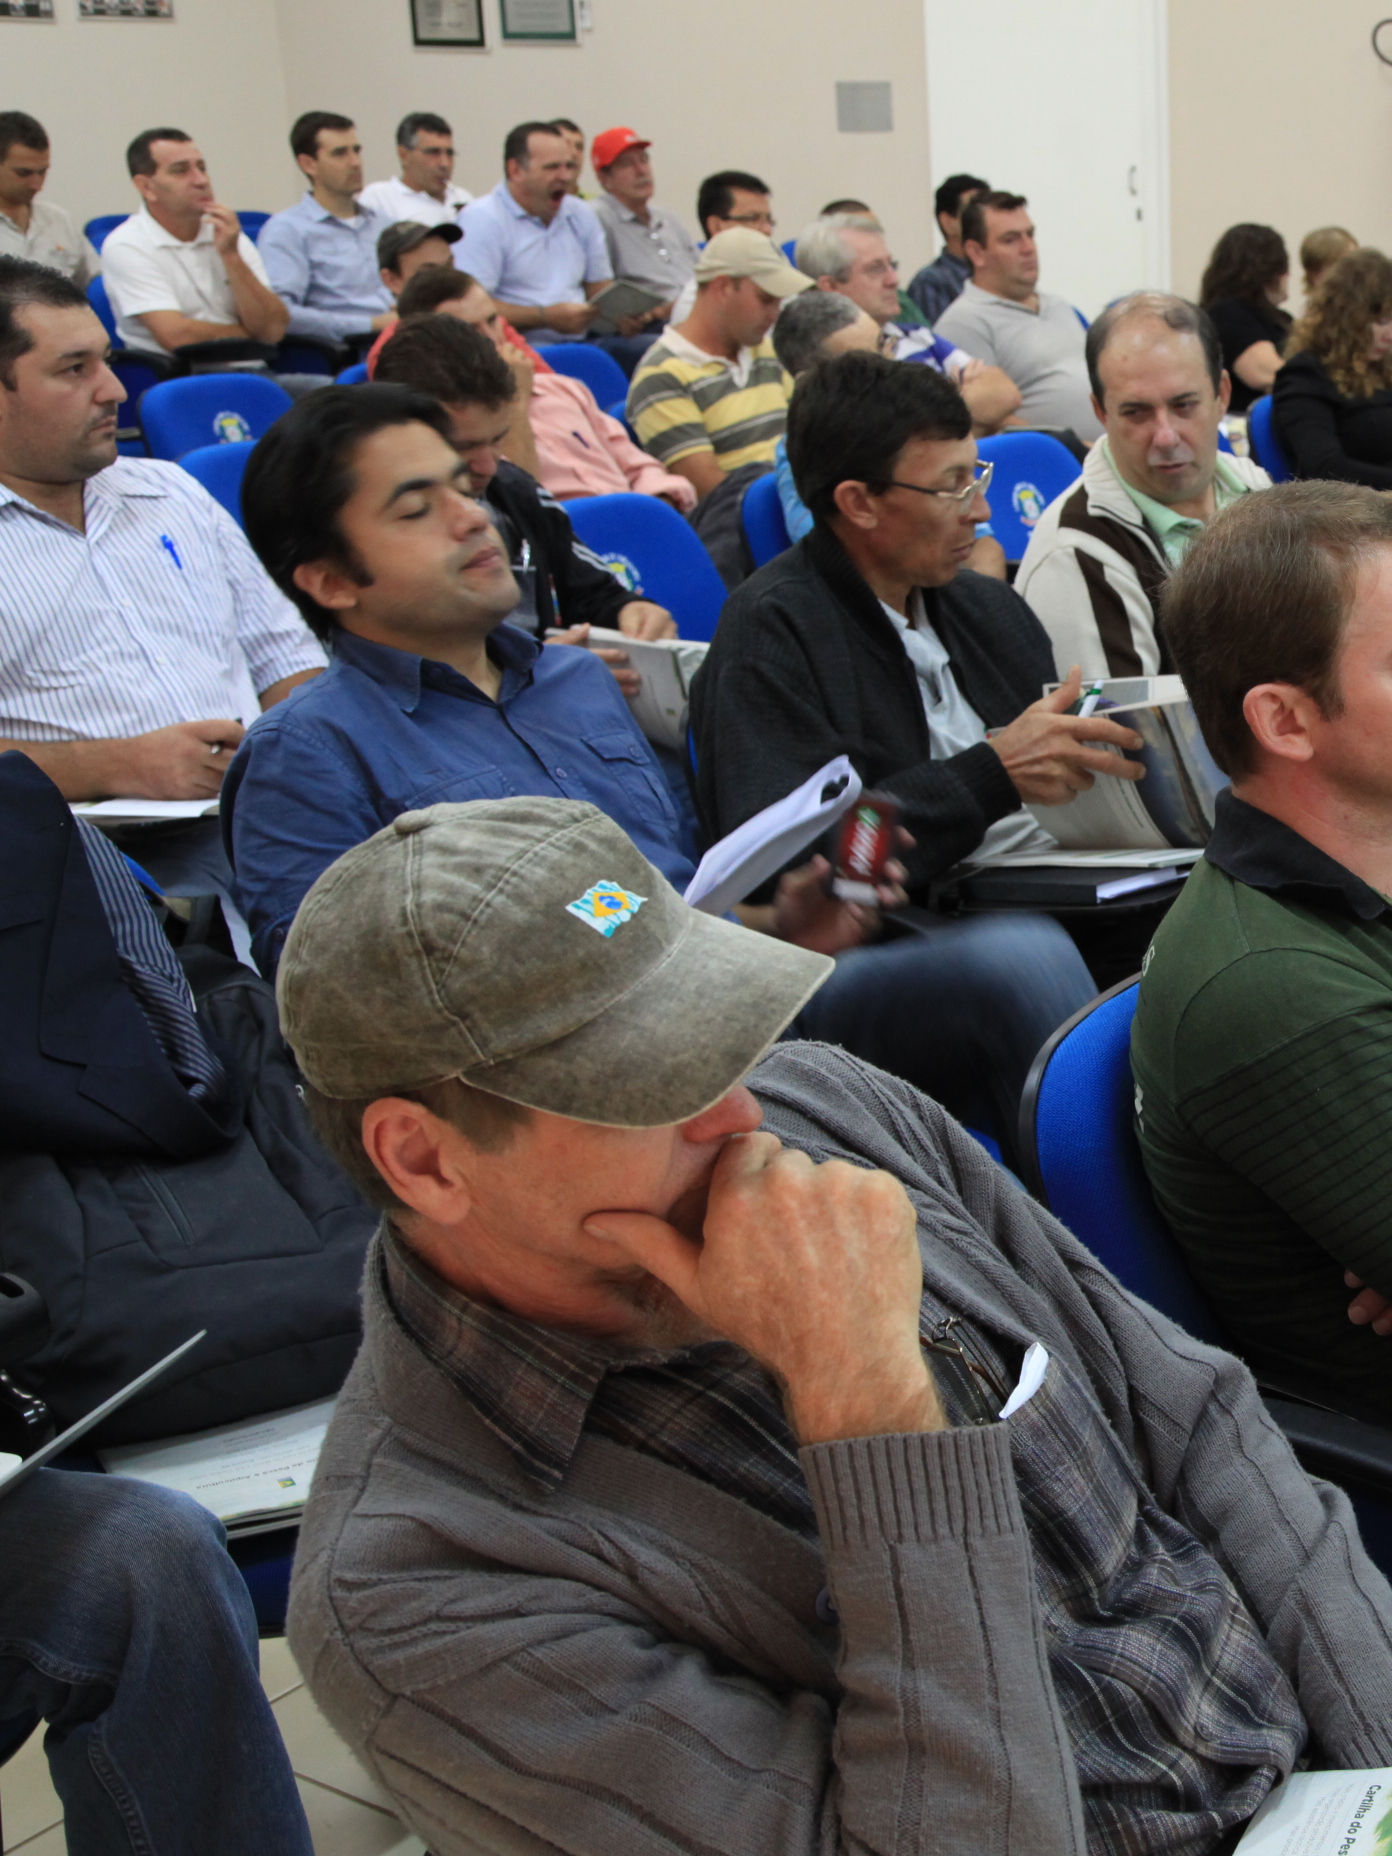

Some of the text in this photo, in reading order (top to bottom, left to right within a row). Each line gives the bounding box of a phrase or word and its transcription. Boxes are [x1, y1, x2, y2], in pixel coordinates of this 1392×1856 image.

[1337, 1784, 1382, 1856] Cartilha do Pes
